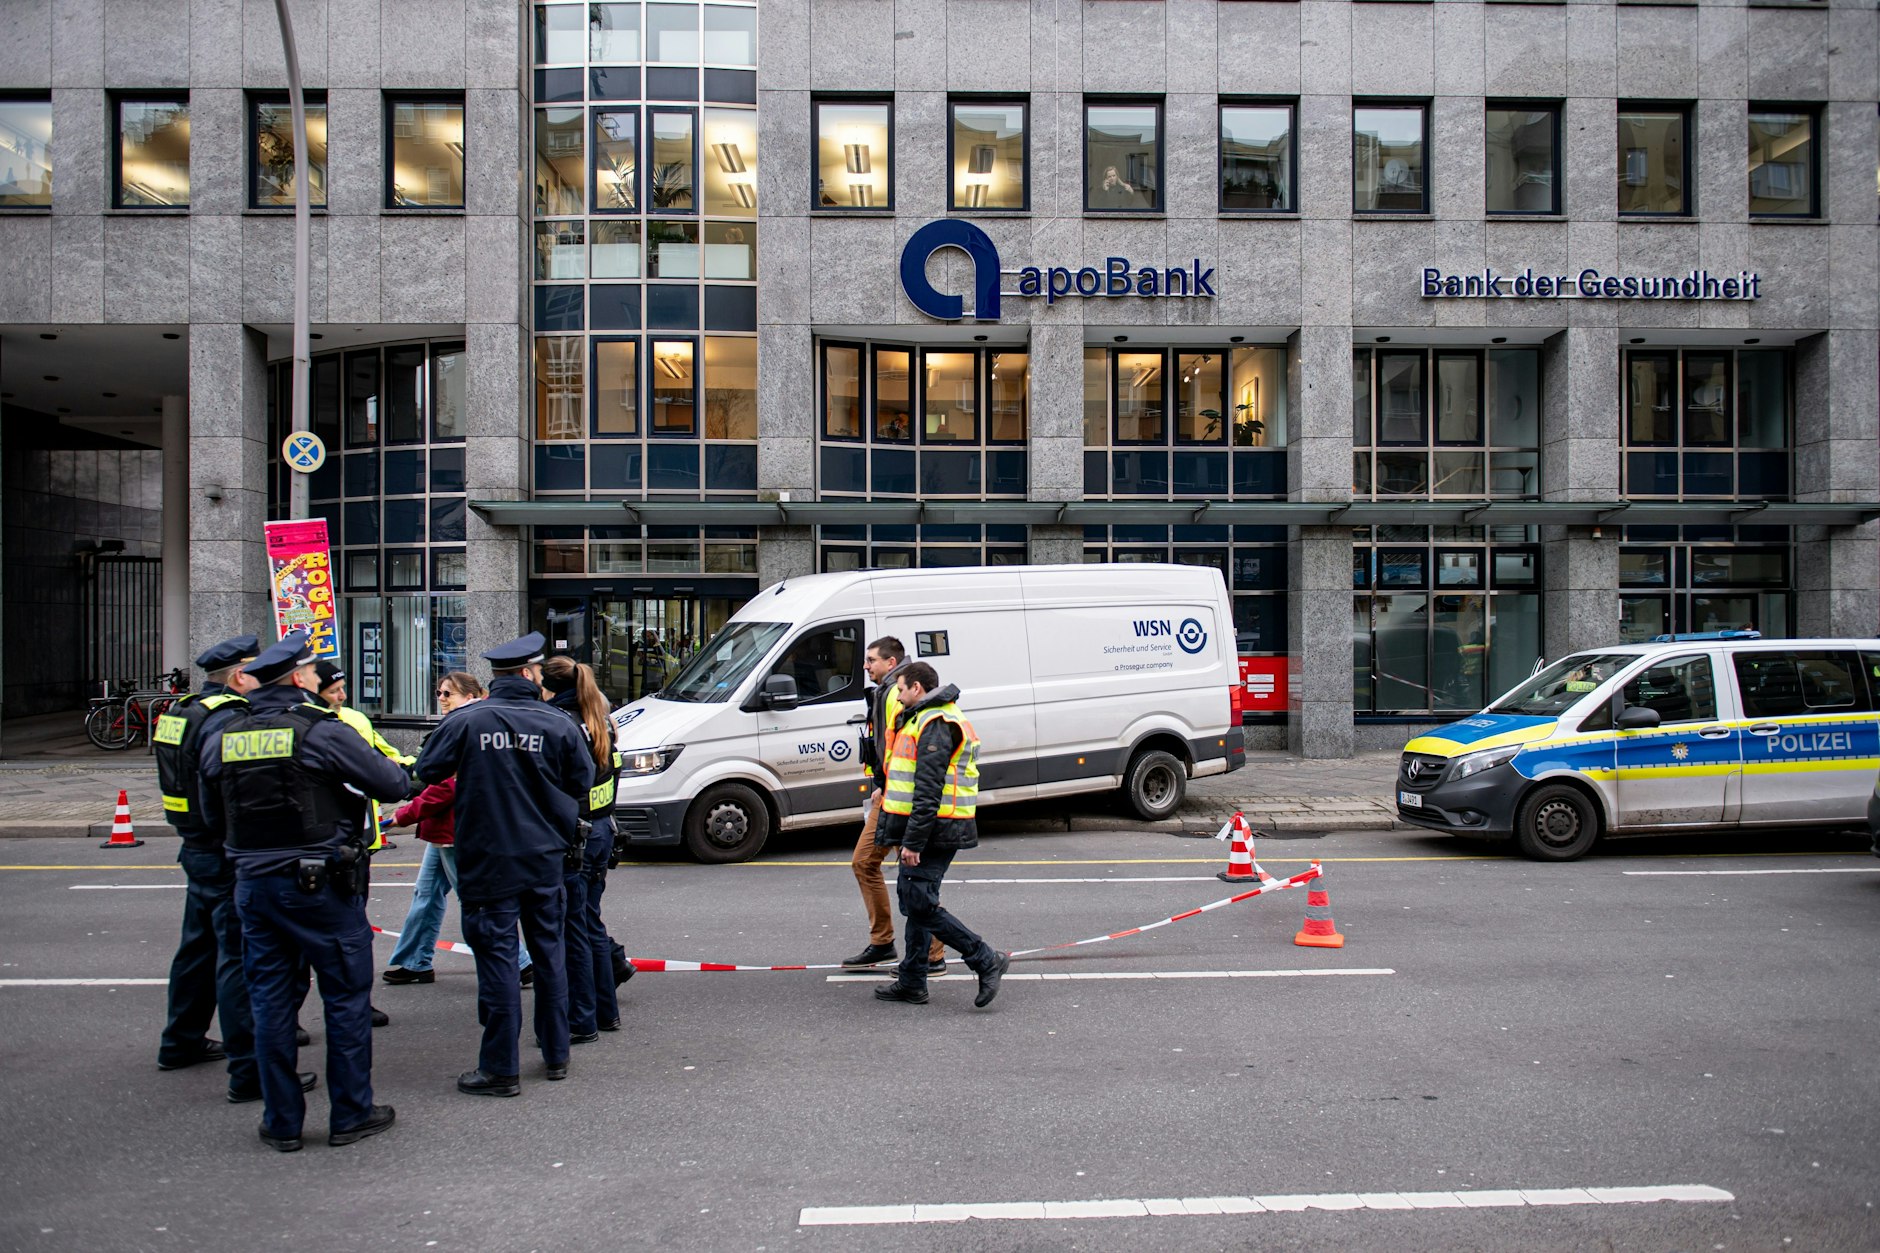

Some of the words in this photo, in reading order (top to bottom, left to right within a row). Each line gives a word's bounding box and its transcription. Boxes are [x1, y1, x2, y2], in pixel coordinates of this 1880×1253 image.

[1019, 257, 1215, 305] apoBank
[1421, 268, 1502, 298] Bank
[1511, 268, 1566, 297] der
[1576, 269, 1762, 300] Gesundheit
[303, 551, 335, 655] ROGALL
[1132, 619, 1172, 637] WSN
[1103, 645, 1135, 655] Sicherheit
[1136, 644, 1149, 652] und
[1150, 643, 1172, 652] Service
[1119, 663, 1146, 671] Prosegur
[1146, 661, 1174, 670] company
[223, 731, 290, 759] POLIZEI
[479, 731, 545, 753] POLIZEI
[798, 742, 826, 755] WSN
[1766, 731, 1853, 753] POLIZEI
